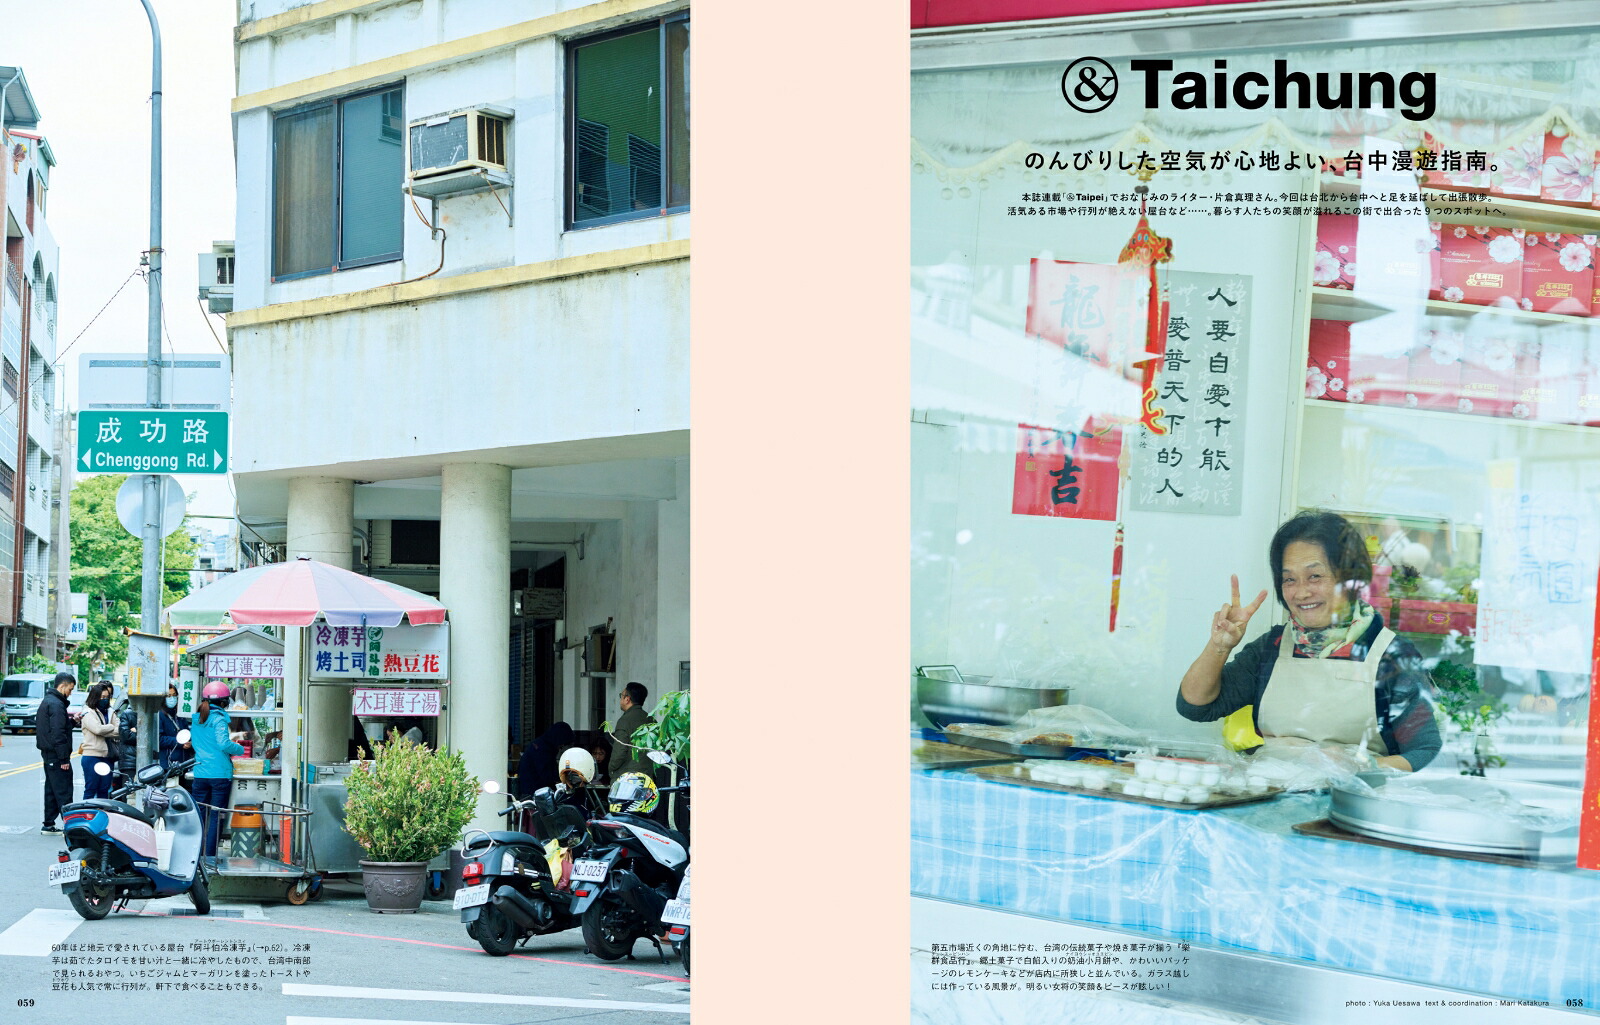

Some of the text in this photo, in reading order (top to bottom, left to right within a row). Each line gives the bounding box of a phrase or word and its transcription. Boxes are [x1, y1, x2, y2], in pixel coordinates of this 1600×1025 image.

[1199, 287, 1237, 472] 人要自愛才能
[1156, 317, 1191, 498] 愛普天下的人
[95, 416, 211, 444] 成功路
[95, 451, 210, 471] Chenggong Rd.
[316, 625, 366, 647] 冷凍芋
[209, 656, 283, 677] 木耳蓮子湯
[316, 650, 366, 673] 烤土司
[368, 641, 381, 676] 阿斗伯
[383, 653, 440, 673] 熱豆花
[182, 680, 194, 713] 阿斗伯
[356, 691, 438, 713] 木耳蓮子湯
[572, 861, 607, 878] NLJ-0237
